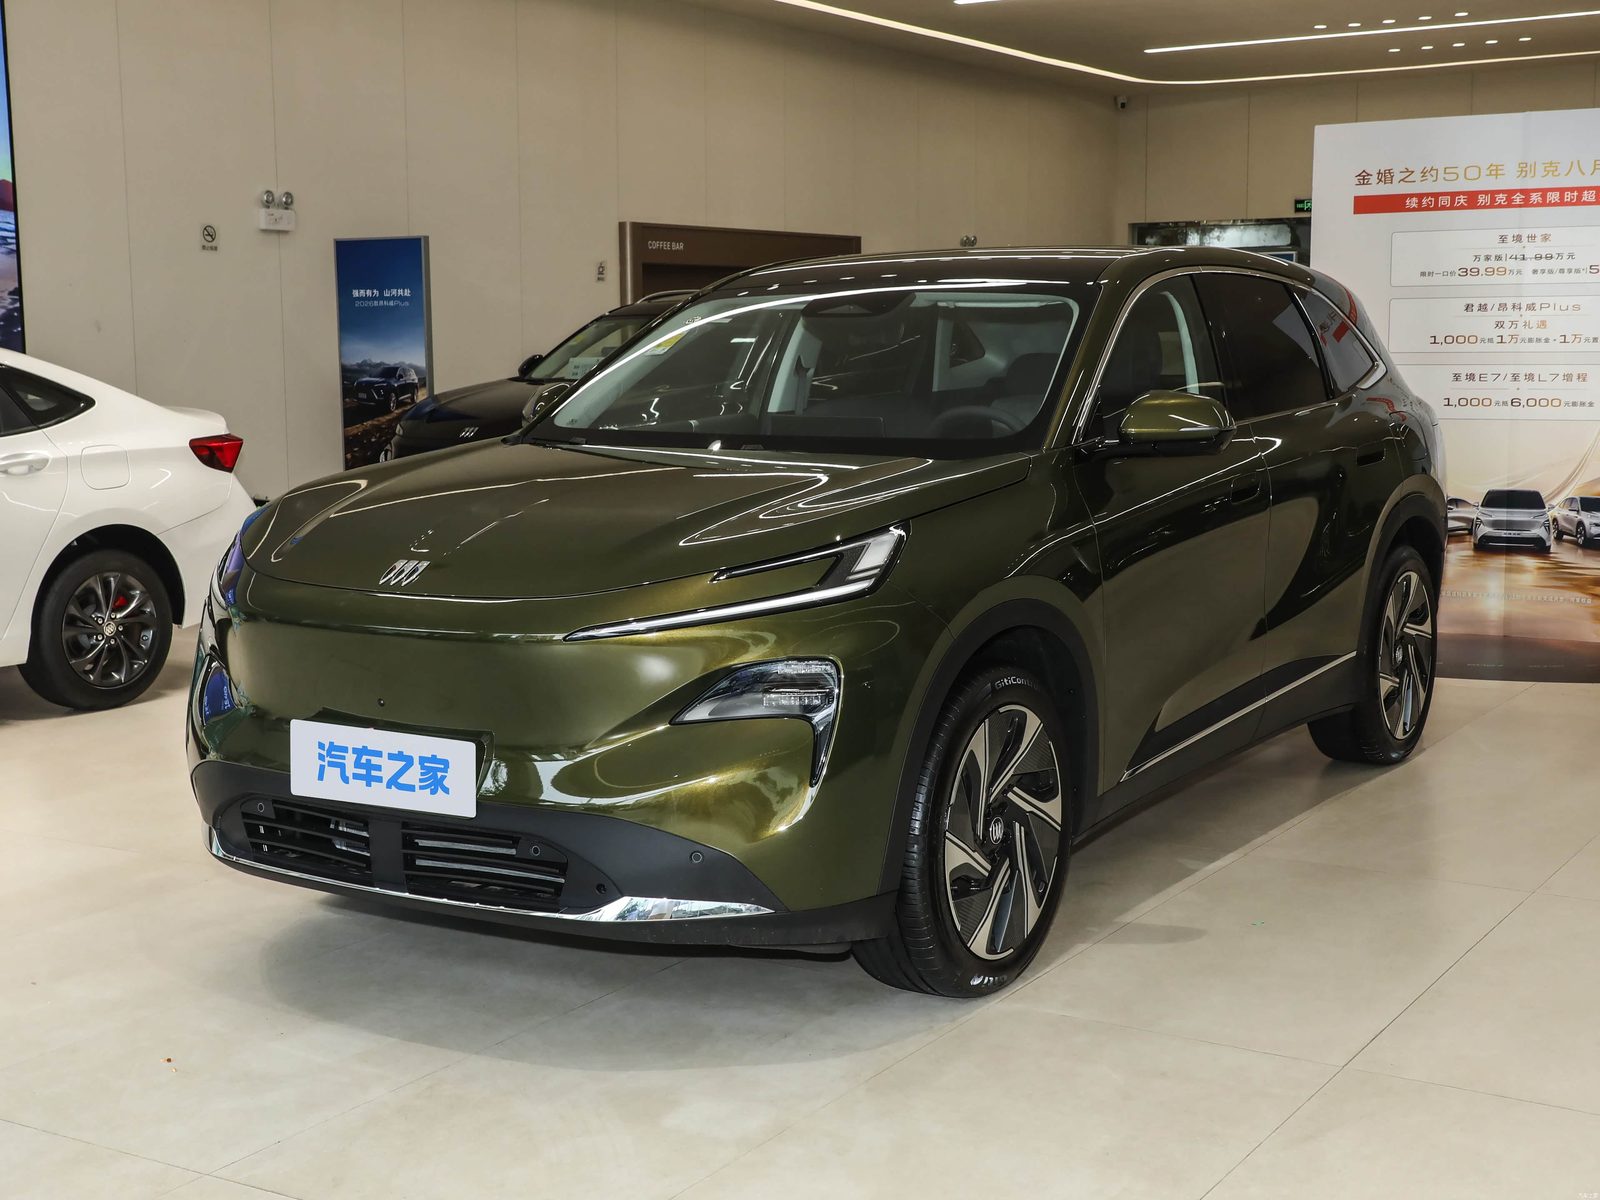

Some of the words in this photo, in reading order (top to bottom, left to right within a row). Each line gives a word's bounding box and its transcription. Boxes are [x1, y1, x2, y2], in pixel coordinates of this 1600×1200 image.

[1354, 162, 1506, 186] 金婚之约50年
[1405, 195, 1468, 209] 续约同庆
[1477, 190, 1597, 207] 别克全系限时超
[1497, 233, 1552, 244] 至境世家
[647, 240, 671, 250] COFFEE
[671, 242, 685, 251] BAR
[1464, 302, 1581, 312] 君越/昂科威Plus
[1494, 320, 1549, 330] 双万礼遇
[1451, 372, 1588, 383] 至境E7/至境L7增程
[317, 740, 450, 796] 汽车之家
